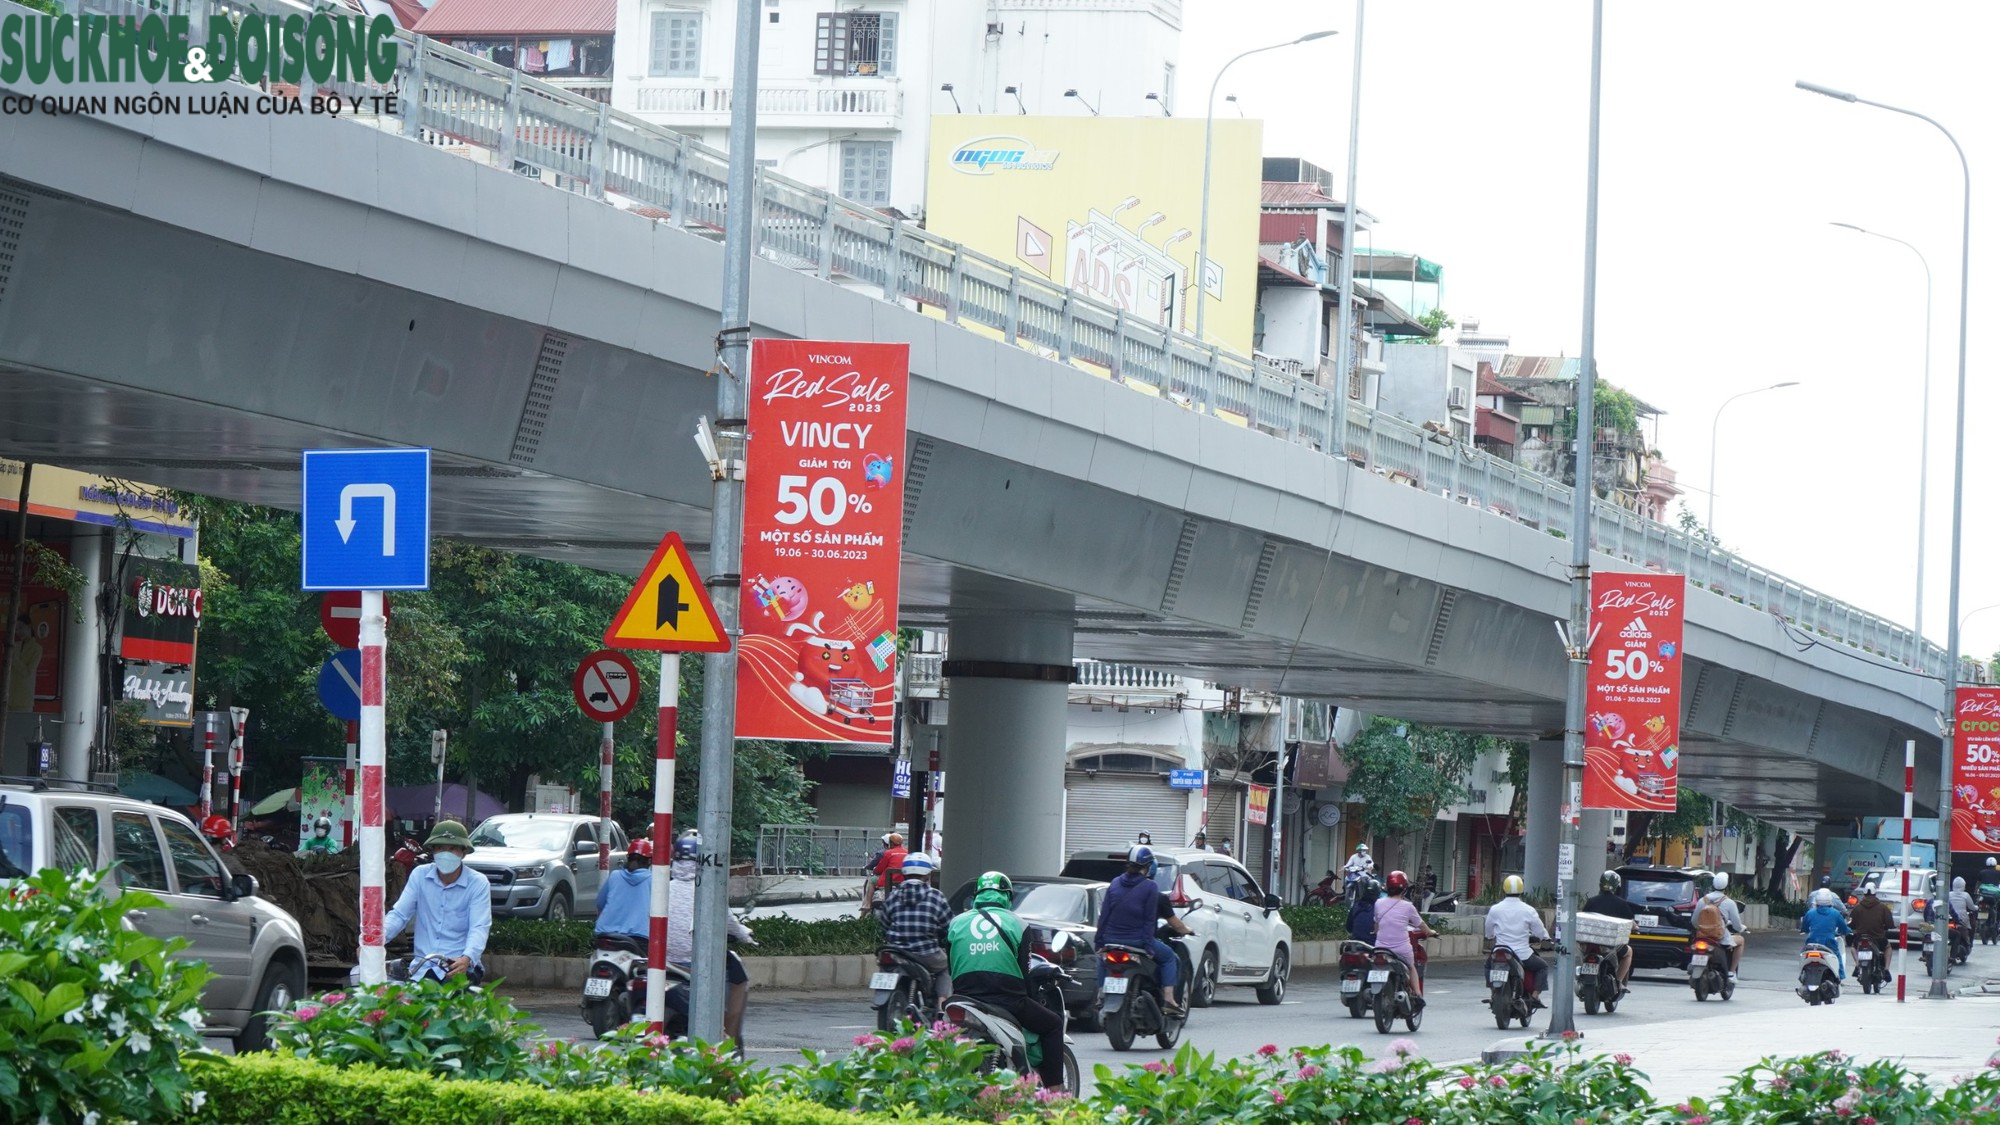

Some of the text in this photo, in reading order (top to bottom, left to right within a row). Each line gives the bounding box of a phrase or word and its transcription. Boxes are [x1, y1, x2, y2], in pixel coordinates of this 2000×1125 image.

[808, 354, 852, 364] VINCOM
[762, 368, 894, 408] Red Sale
[849, 404, 881, 412] 2023
[780, 420, 872, 449] VINCY
[799, 457, 852, 470] GIẢM TỚI
[774, 474, 872, 526] 50%
[760, 528, 790, 545] MỘT
[793, 530, 812, 544] SỐ
[814, 530, 842, 544] SẢN
[775, 548, 802, 557] 19.06
[812, 549, 868, 560] 30.06.2023
[1620, 630, 1652, 639] adidas
[1624, 640, 1646, 648] GIẢM
[1604, 650, 1664, 680] 50%
[1596, 684, 1614, 694] MỘT
[1616, 684, 1628, 693] SỐ
[1629, 684, 1646, 694] SẢN
[1982, 700, 2000, 716] Sa
[970, 940, 1000, 955] gojek
